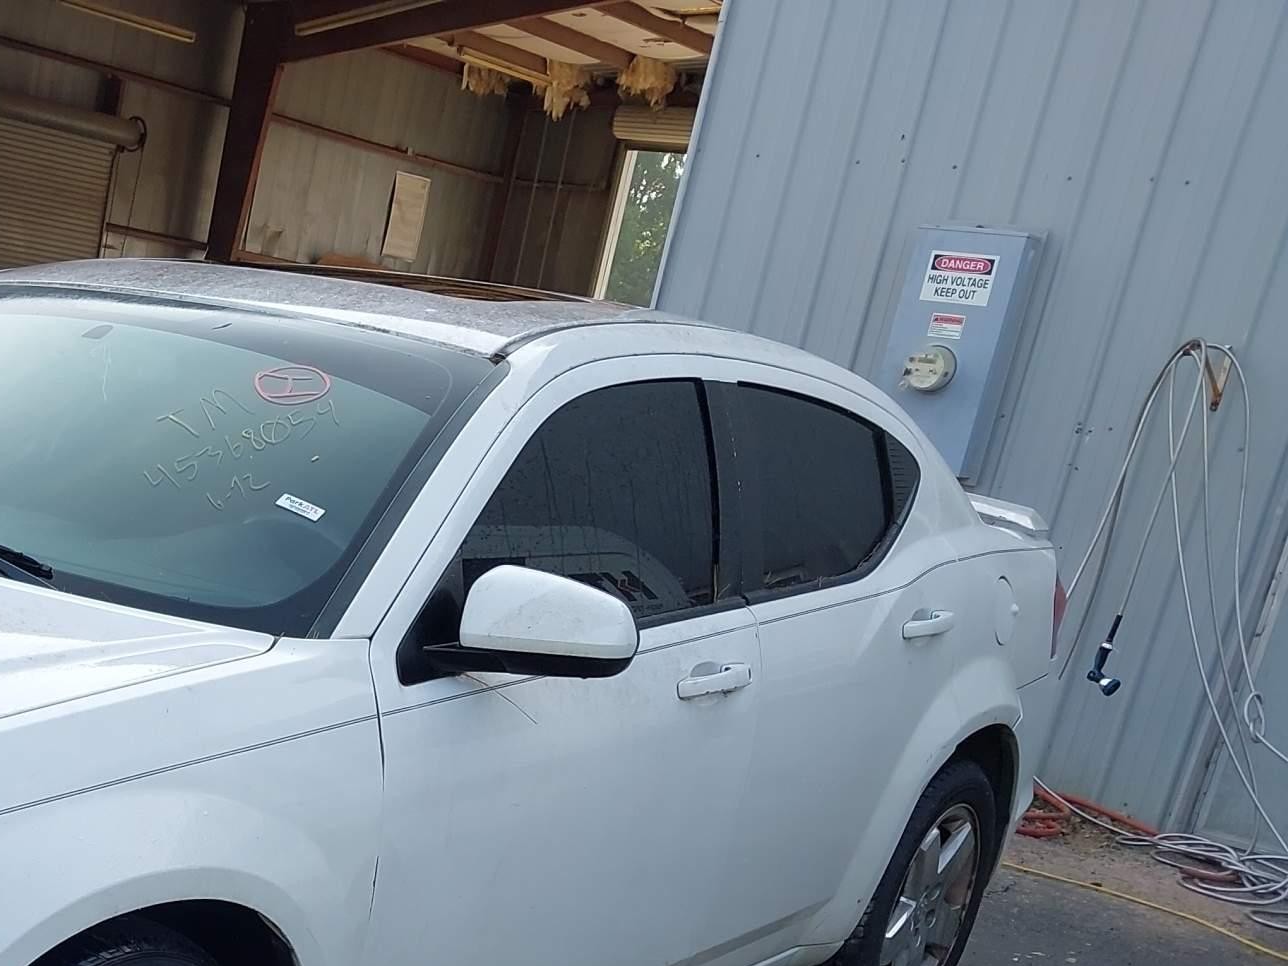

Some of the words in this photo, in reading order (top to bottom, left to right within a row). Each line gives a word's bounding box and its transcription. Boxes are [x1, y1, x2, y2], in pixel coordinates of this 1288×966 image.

[940, 257, 985, 271] DANGER
[927, 274, 949, 286] HIGH
[951, 276, 990, 289] VOLTAGE
[933, 287, 957, 298] KEEP
[958, 289, 977, 301] OUT
